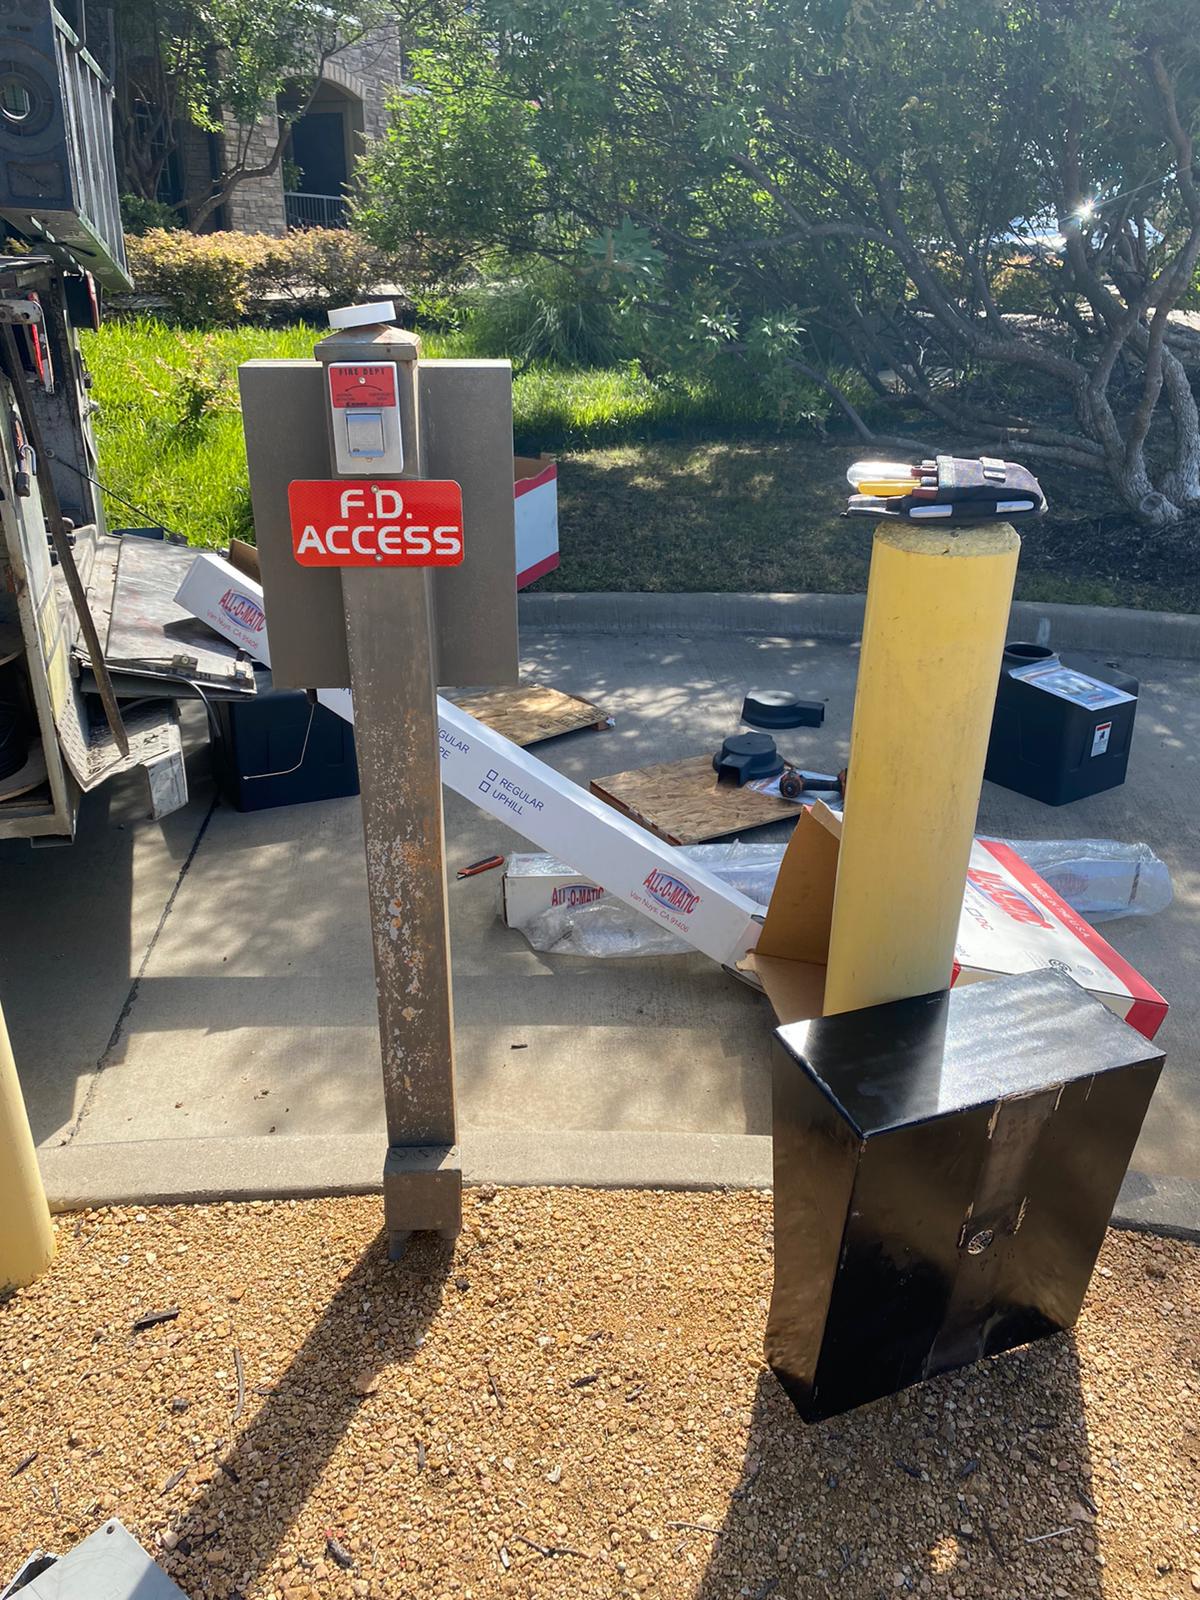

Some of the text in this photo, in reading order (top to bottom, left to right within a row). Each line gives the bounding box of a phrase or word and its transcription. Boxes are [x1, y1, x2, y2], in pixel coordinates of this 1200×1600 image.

[338, 367, 359, 376] FIRE
[340, 489, 413, 519] F.D.
[297, 525, 461, 555] ACCESS
[437, 728, 470, 754] GULAR
[492, 789, 524, 815] UPHILL
[500, 778, 545, 812] REGULAR
[630, 890, 642, 902] Van
[659, 910, 670, 921] CA
[643, 868, 700, 914] ALL-O-MATIC
